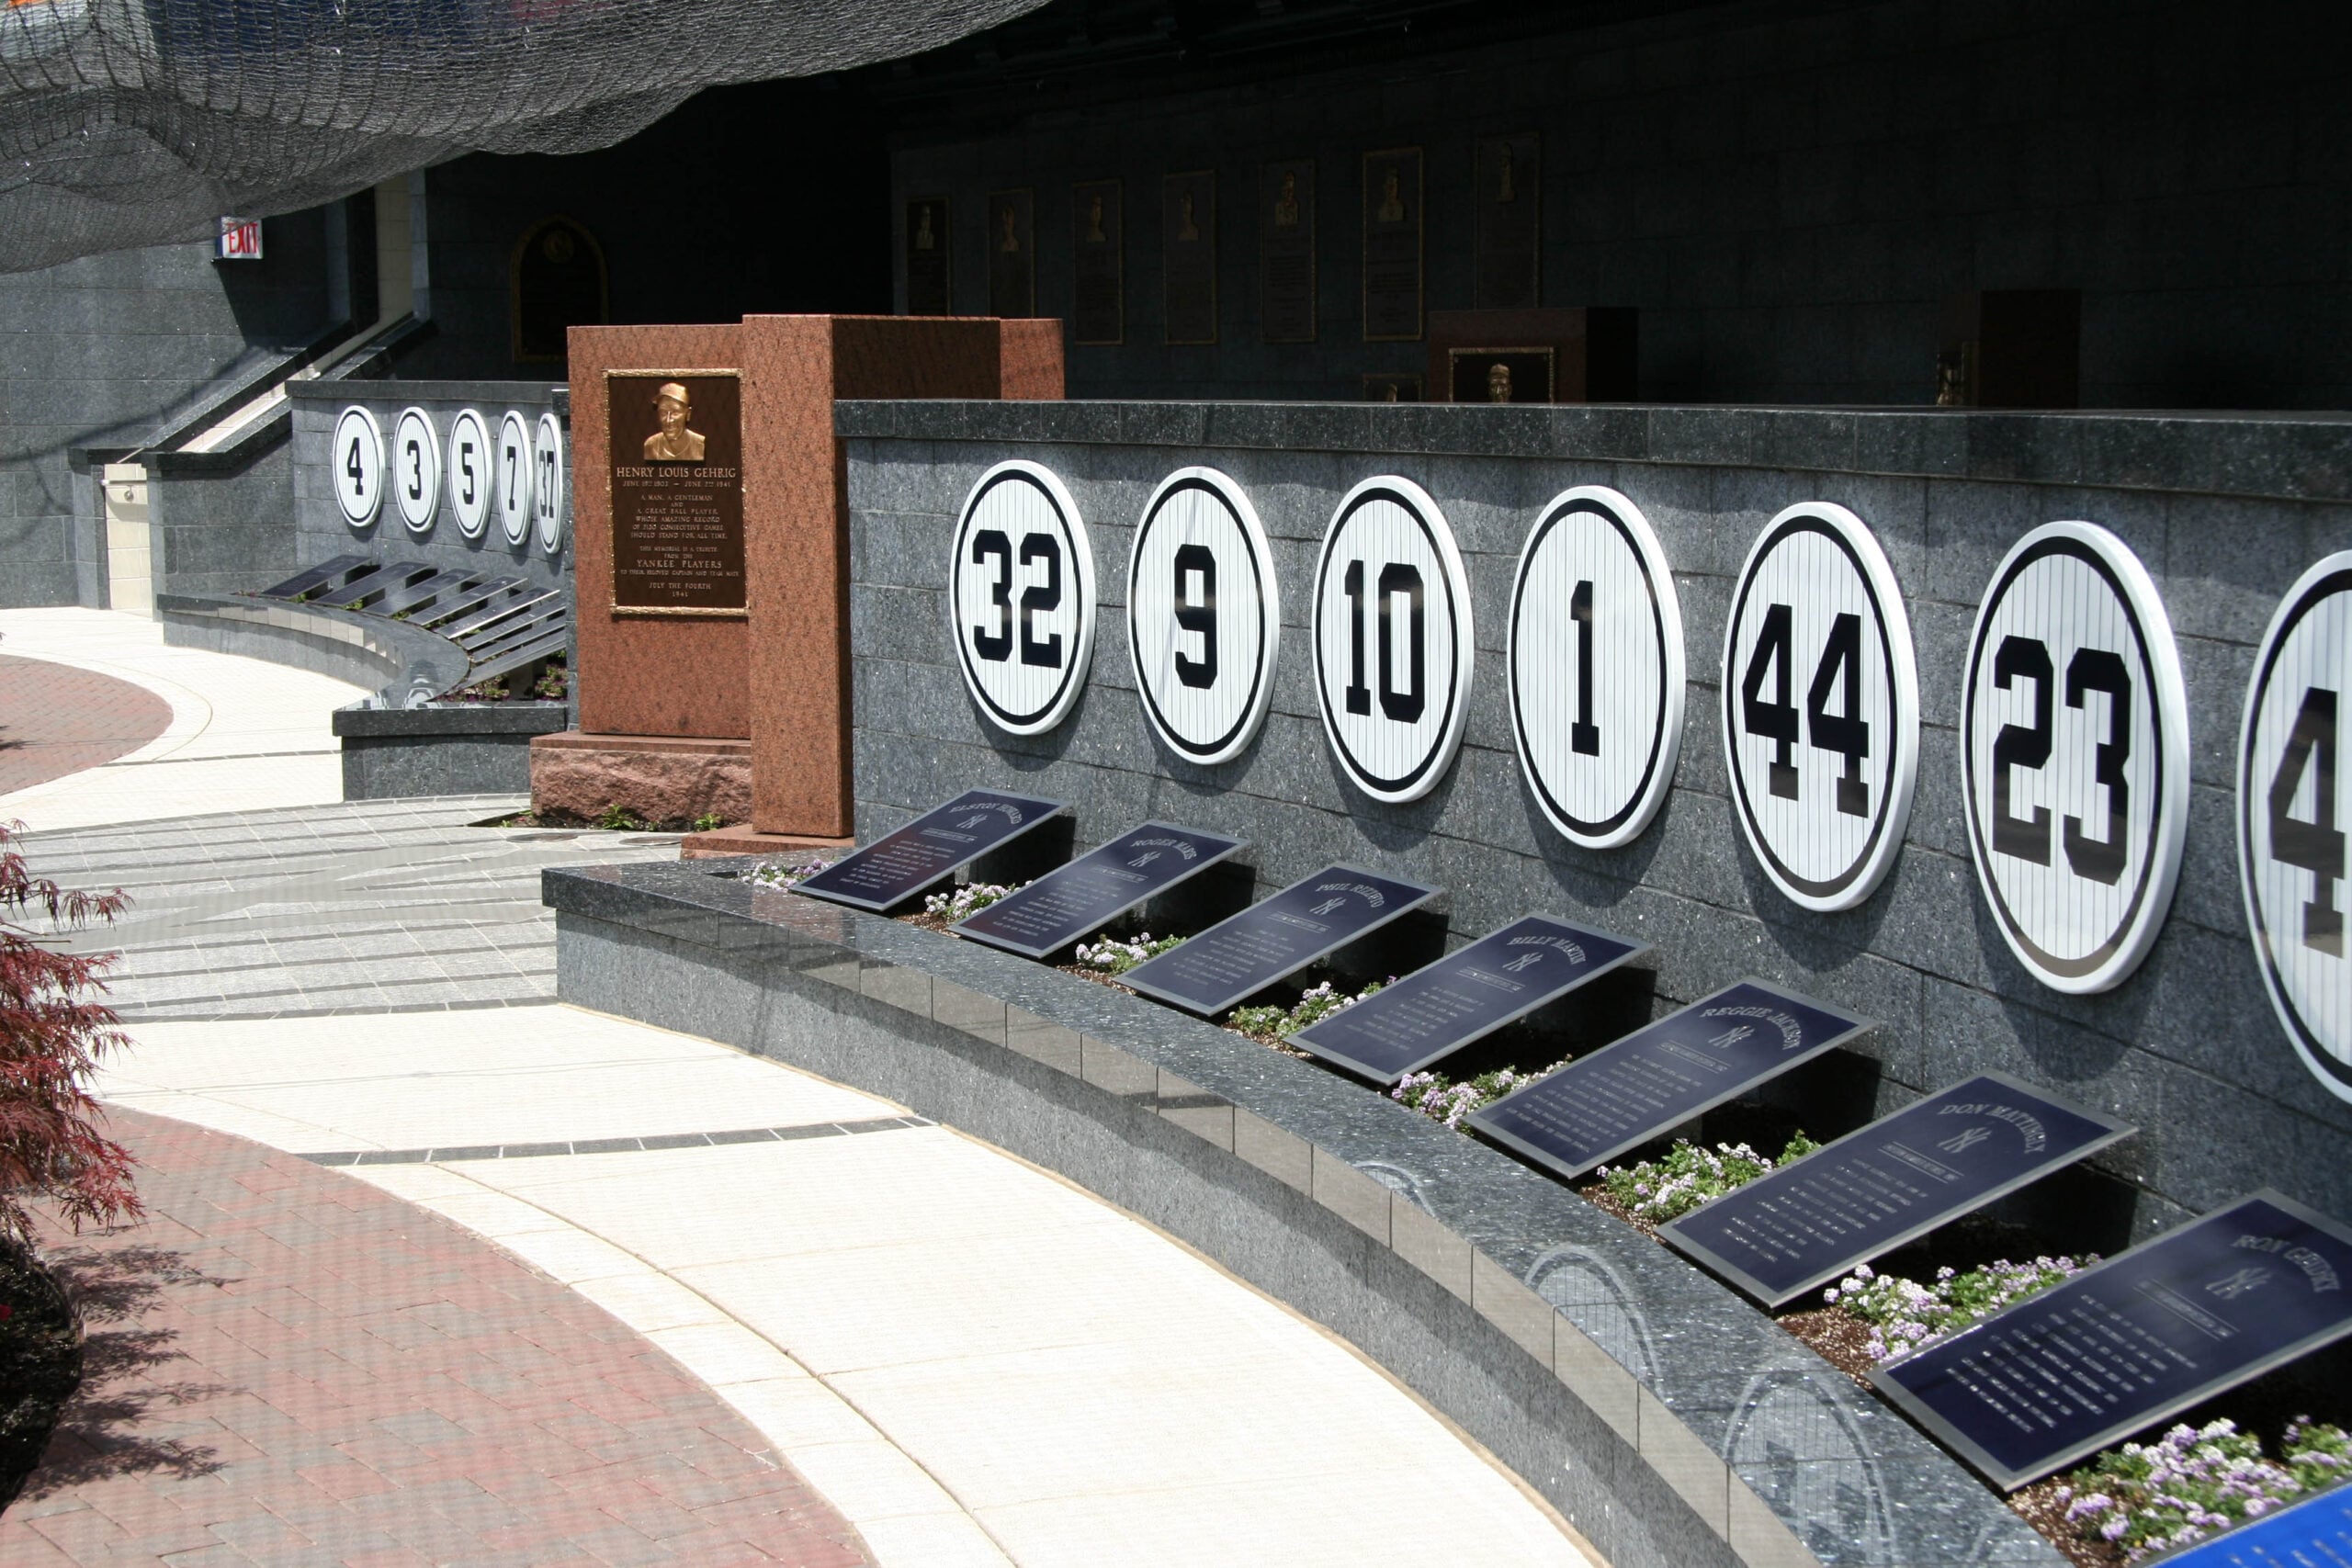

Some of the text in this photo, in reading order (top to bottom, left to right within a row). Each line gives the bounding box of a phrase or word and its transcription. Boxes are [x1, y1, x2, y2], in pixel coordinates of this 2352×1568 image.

[227, 222, 259, 254] EXIT
[346, 437, 364, 497] 4
[406, 439, 422, 501] 3
[461, 442, 474, 505] 5
[506, 446, 516, 511] 7
[538, 450, 555, 518] 37
[616, 467, 737, 478] HENRY LOUIS GEHRIG
[637, 559, 722, 568] YANKEE PLAYERS
[972, 529, 1063, 671] 32
[1174, 544, 1217, 690] 9
[1344, 559, 1425, 724] 10
[1570, 580, 1600, 758] 1
[1741, 603, 1871, 819] 44
[1992, 634, 2133, 887] 23
[1130, 839, 1177, 847] ROGER
[2267, 686, 2346, 959] 4
[1316, 883, 1351, 892] PHIL
[1506, 936, 1587, 965] BILLY MARTIN
[1700, 1007, 1802, 1050] REGGIE JACKSON
[1937, 1104, 2046, 1154] DON MATTINGLY
[2229, 1235, 2342, 1293] RON GUIDRY
